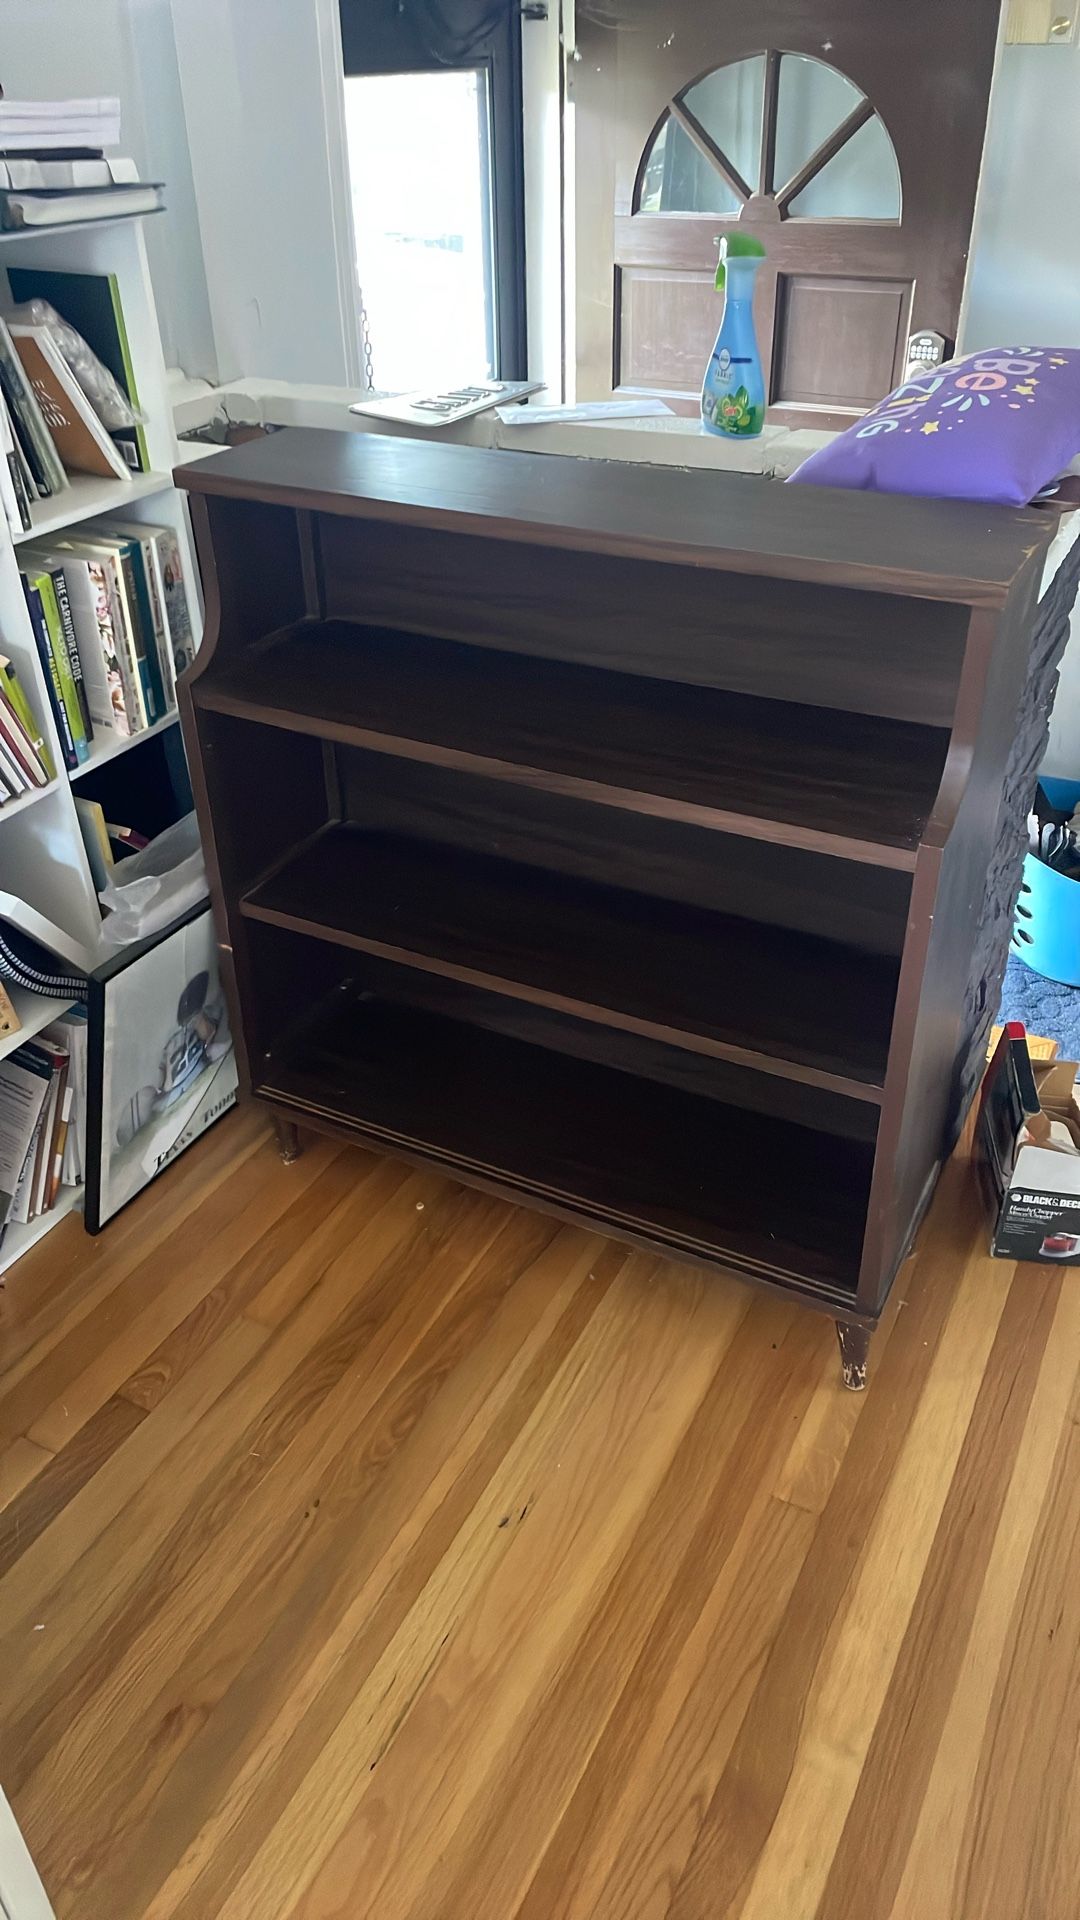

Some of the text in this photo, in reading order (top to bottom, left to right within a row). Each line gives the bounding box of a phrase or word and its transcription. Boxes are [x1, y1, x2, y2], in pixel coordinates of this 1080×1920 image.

[955, 358, 1041, 390] Be
[56, 575, 83, 682] THE CARNIVORE CODE
